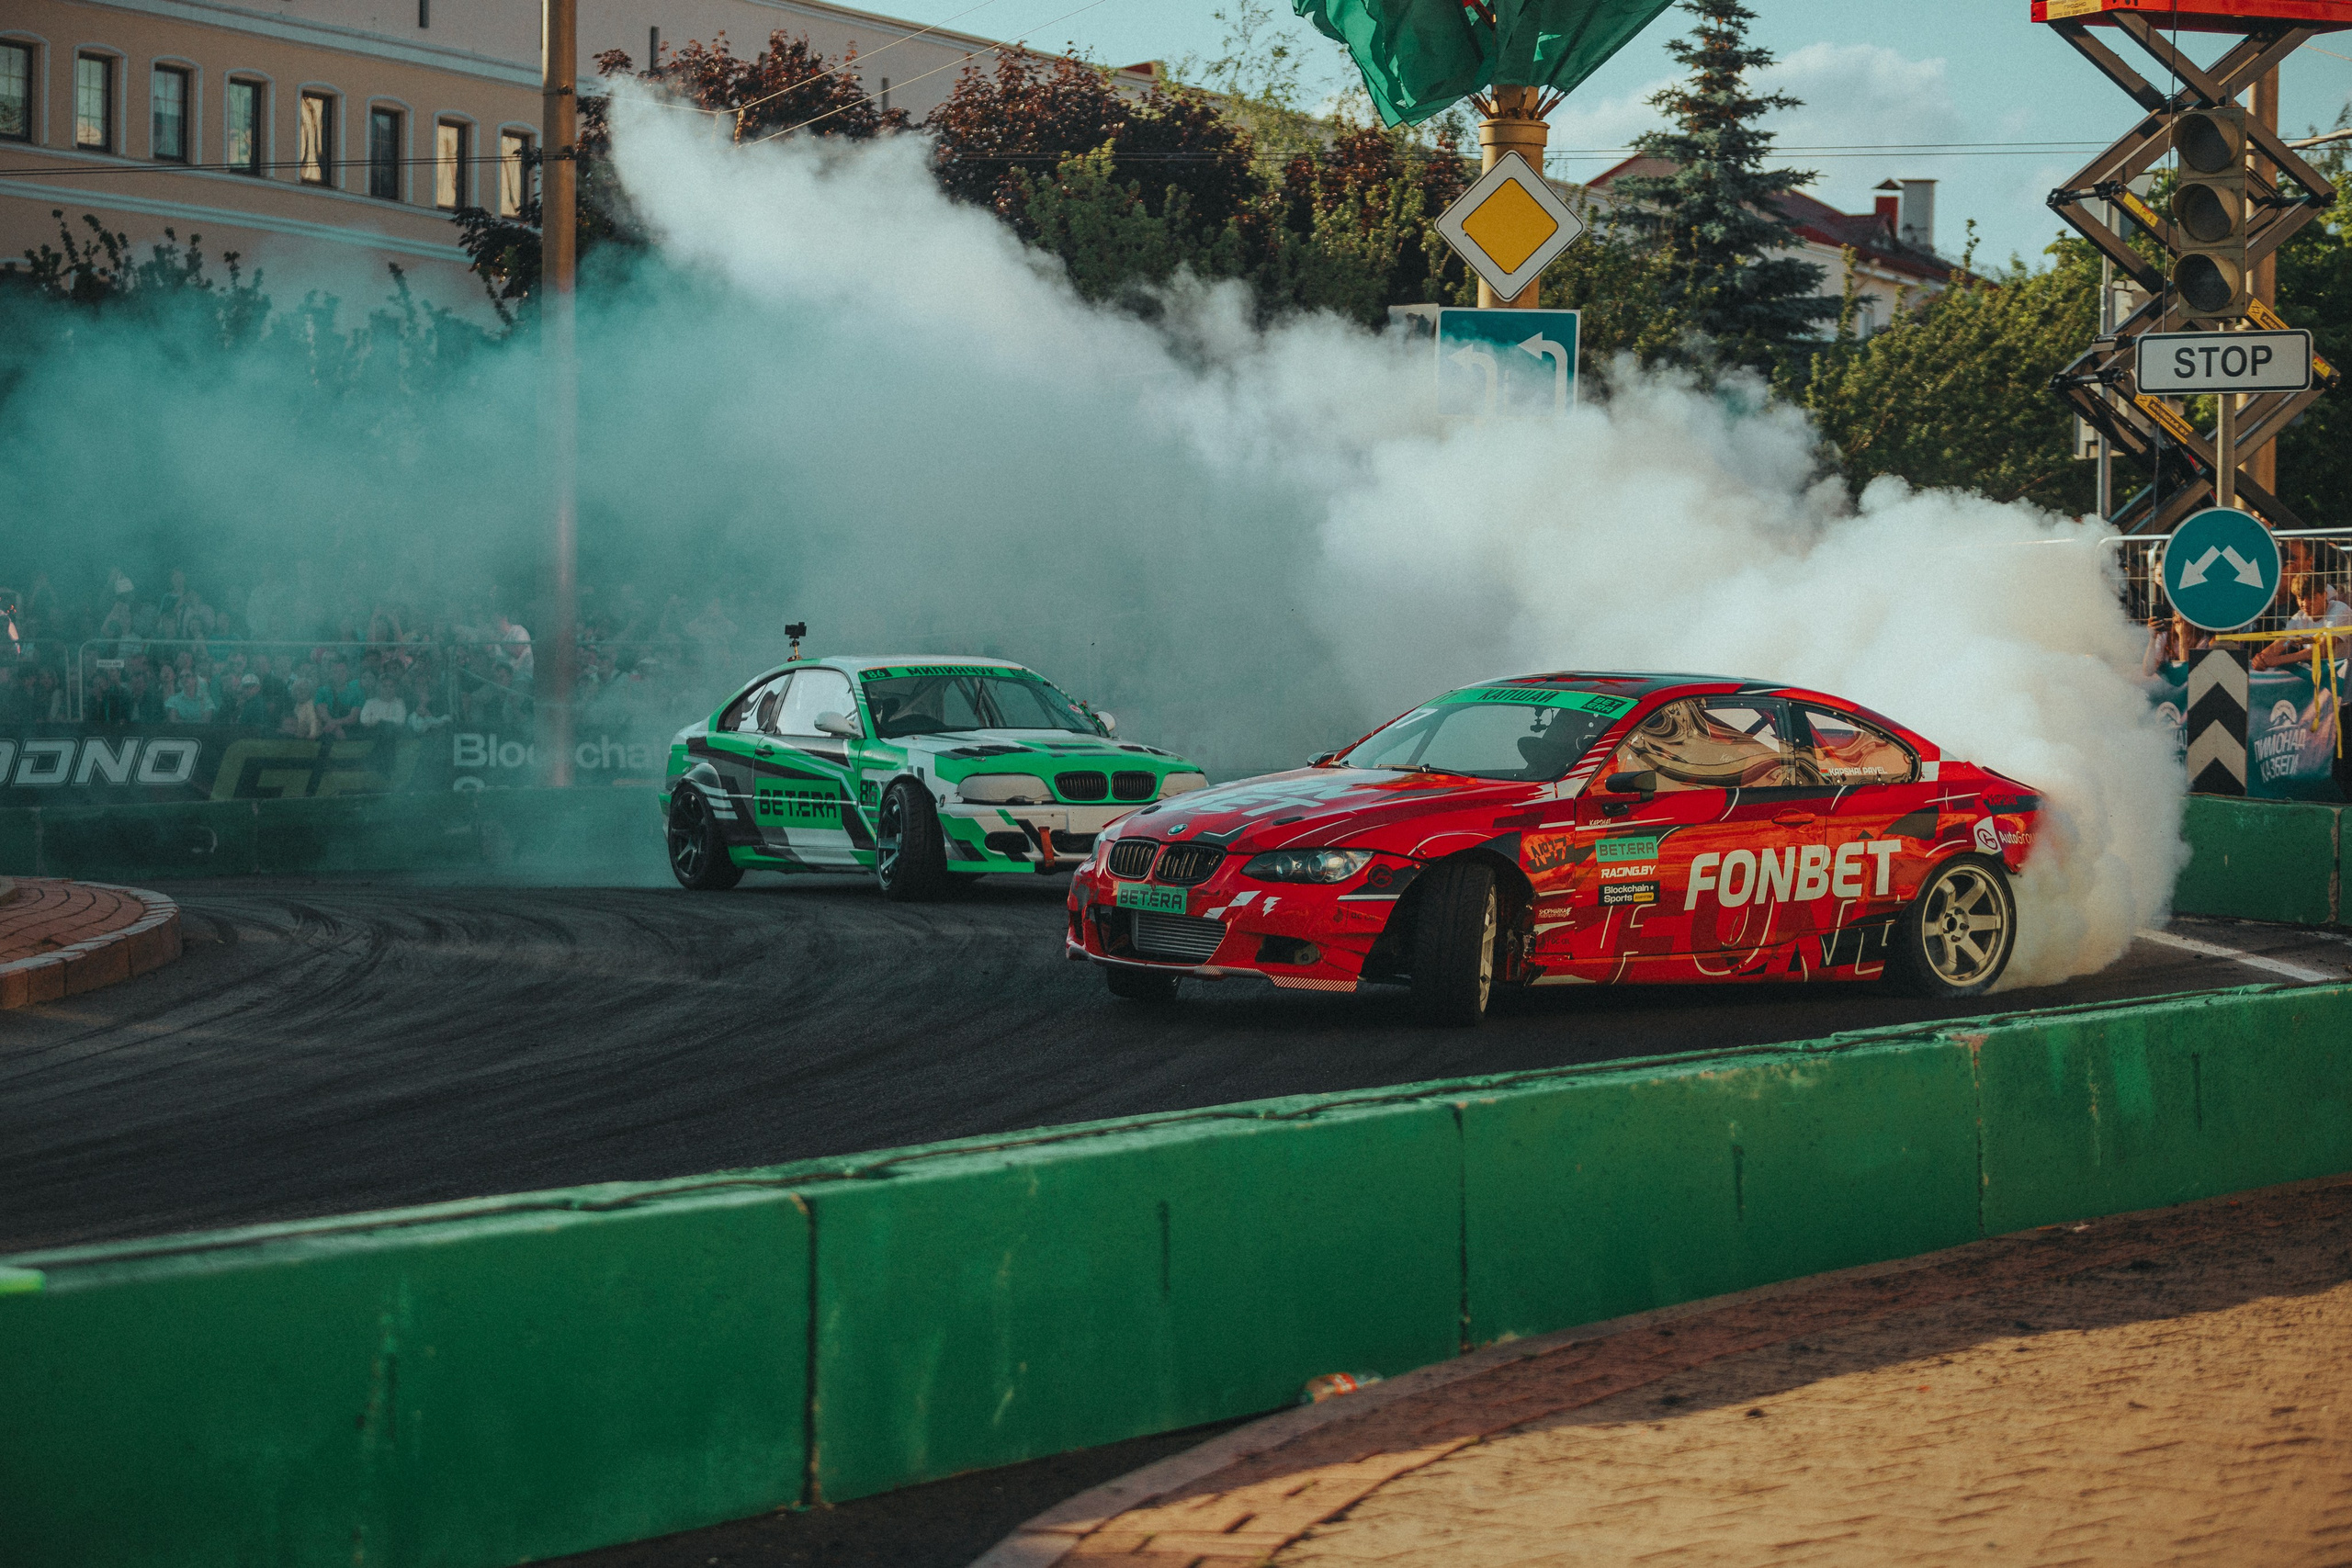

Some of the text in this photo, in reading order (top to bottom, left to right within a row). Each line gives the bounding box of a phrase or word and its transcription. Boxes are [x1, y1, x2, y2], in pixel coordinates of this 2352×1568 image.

[2174, 345, 2273, 378] STOP
[867, 670, 886, 678] 86
[1593, 697, 1623, 707] BET
[859, 779, 878, 807] 86
[1600, 864, 1657, 879] RACING.BY
[1683, 839, 1902, 911] FONBET
[1603, 884, 1649, 895] Blockchain
[1603, 894, 1633, 905] Sports
